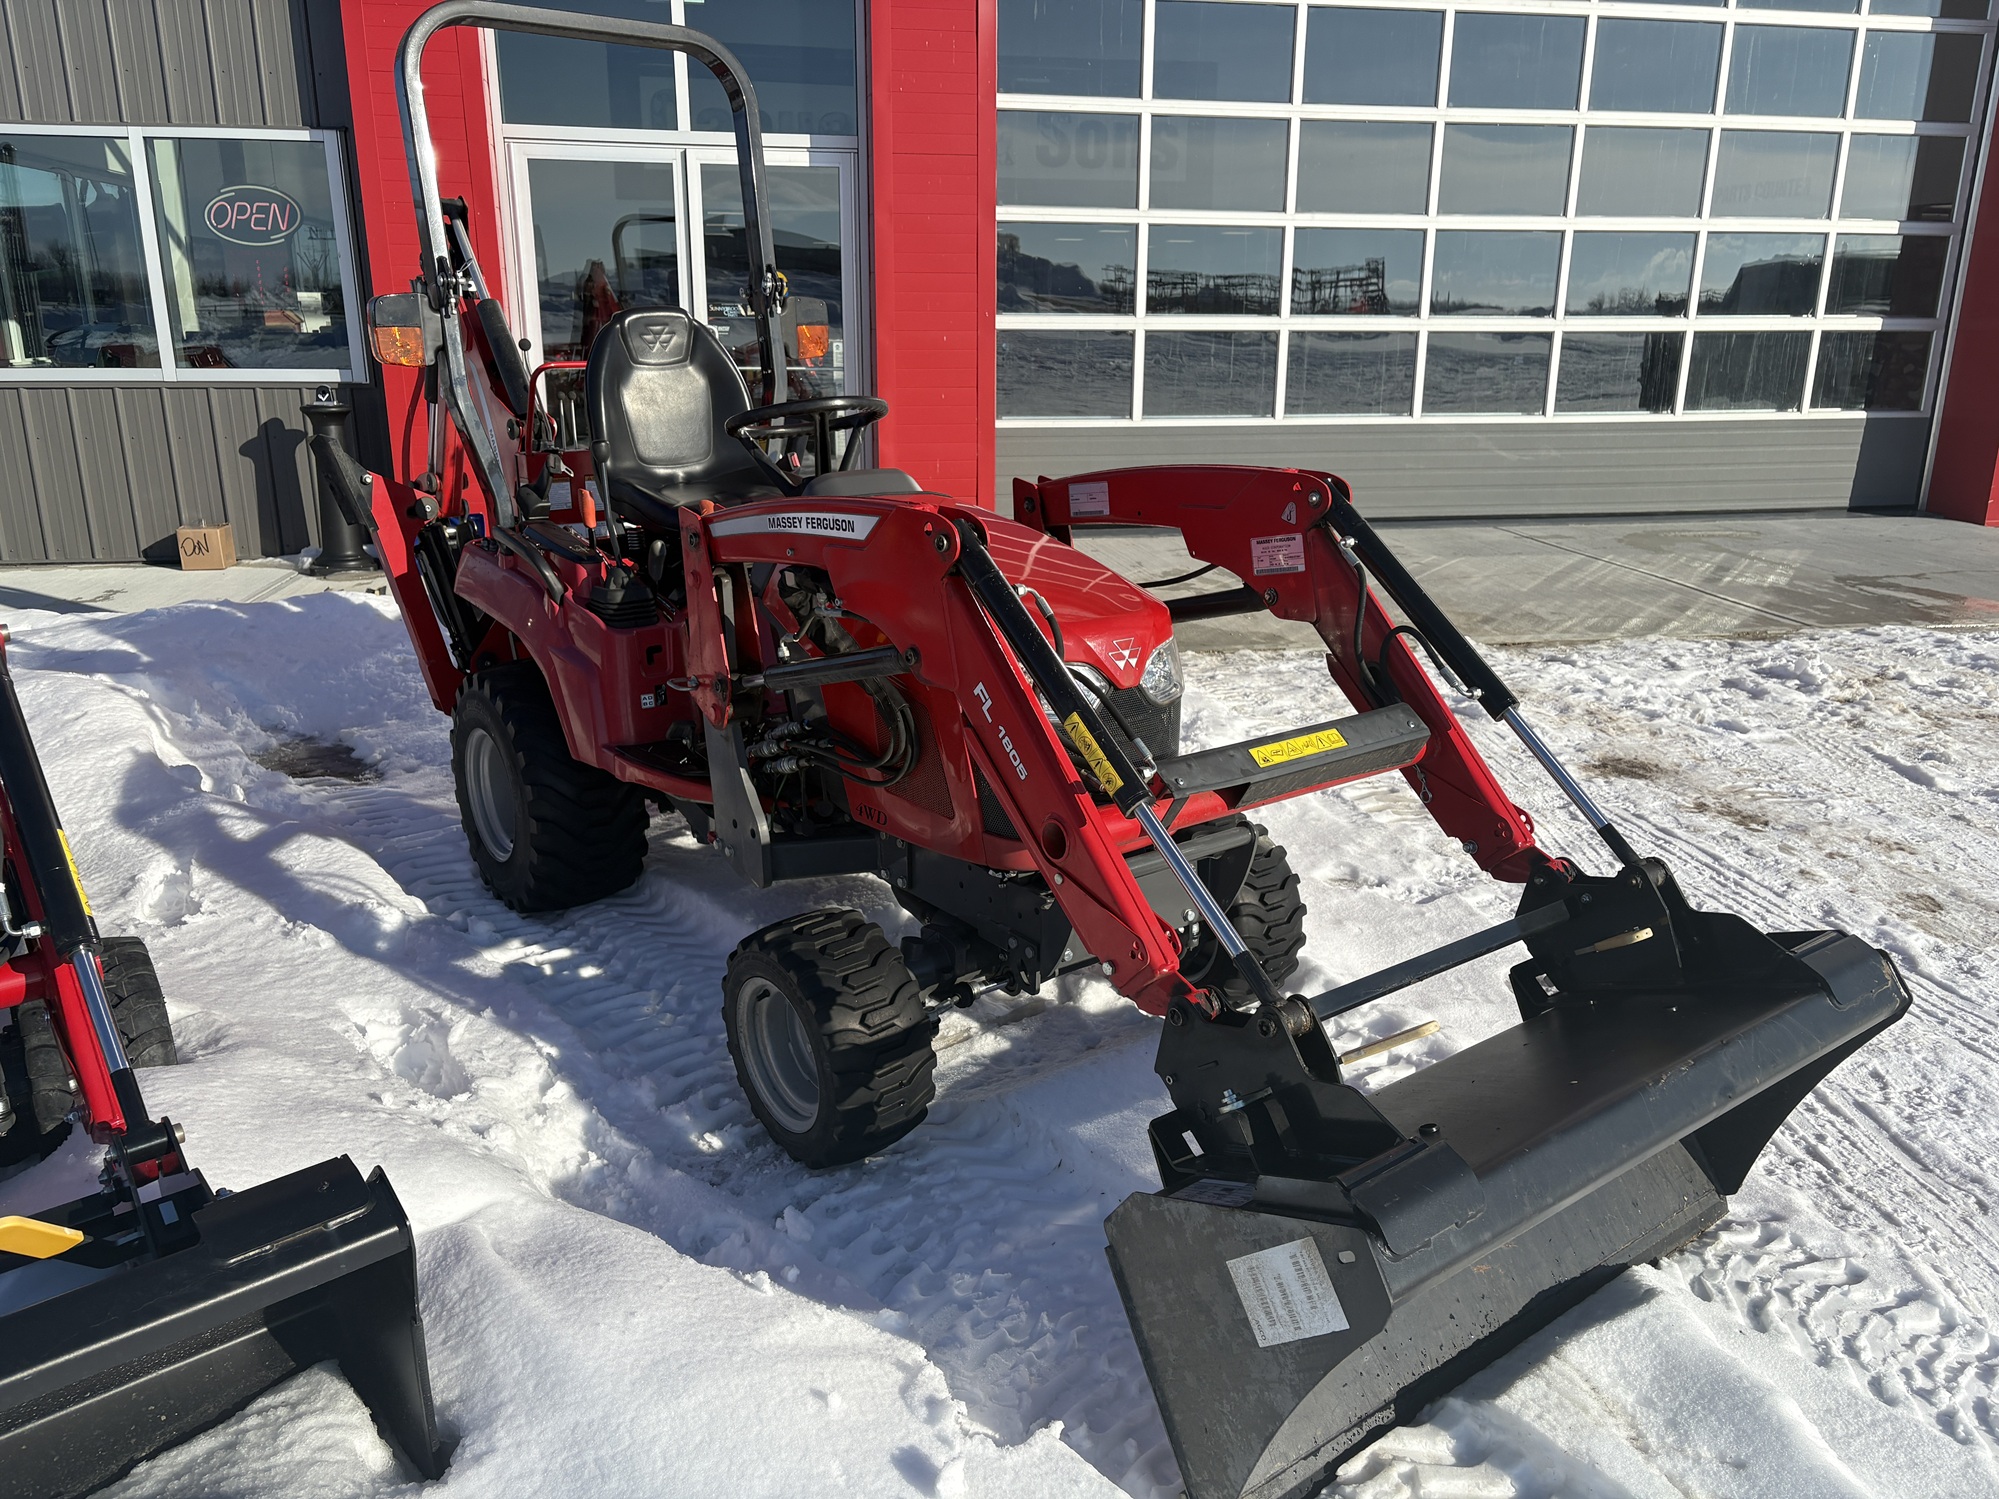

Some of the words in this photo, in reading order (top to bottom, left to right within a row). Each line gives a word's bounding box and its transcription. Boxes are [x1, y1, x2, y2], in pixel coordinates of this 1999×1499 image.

[210, 201, 290, 231] OPEN
[768, 516, 803, 529] MASSEY
[805, 517, 855, 533] FERGUSON
[1274, 536, 1296, 544] FERGUSON
[973, 681, 993, 724] FL
[998, 725, 1028, 781] 1805
[856, 802, 888, 826] 4WD
